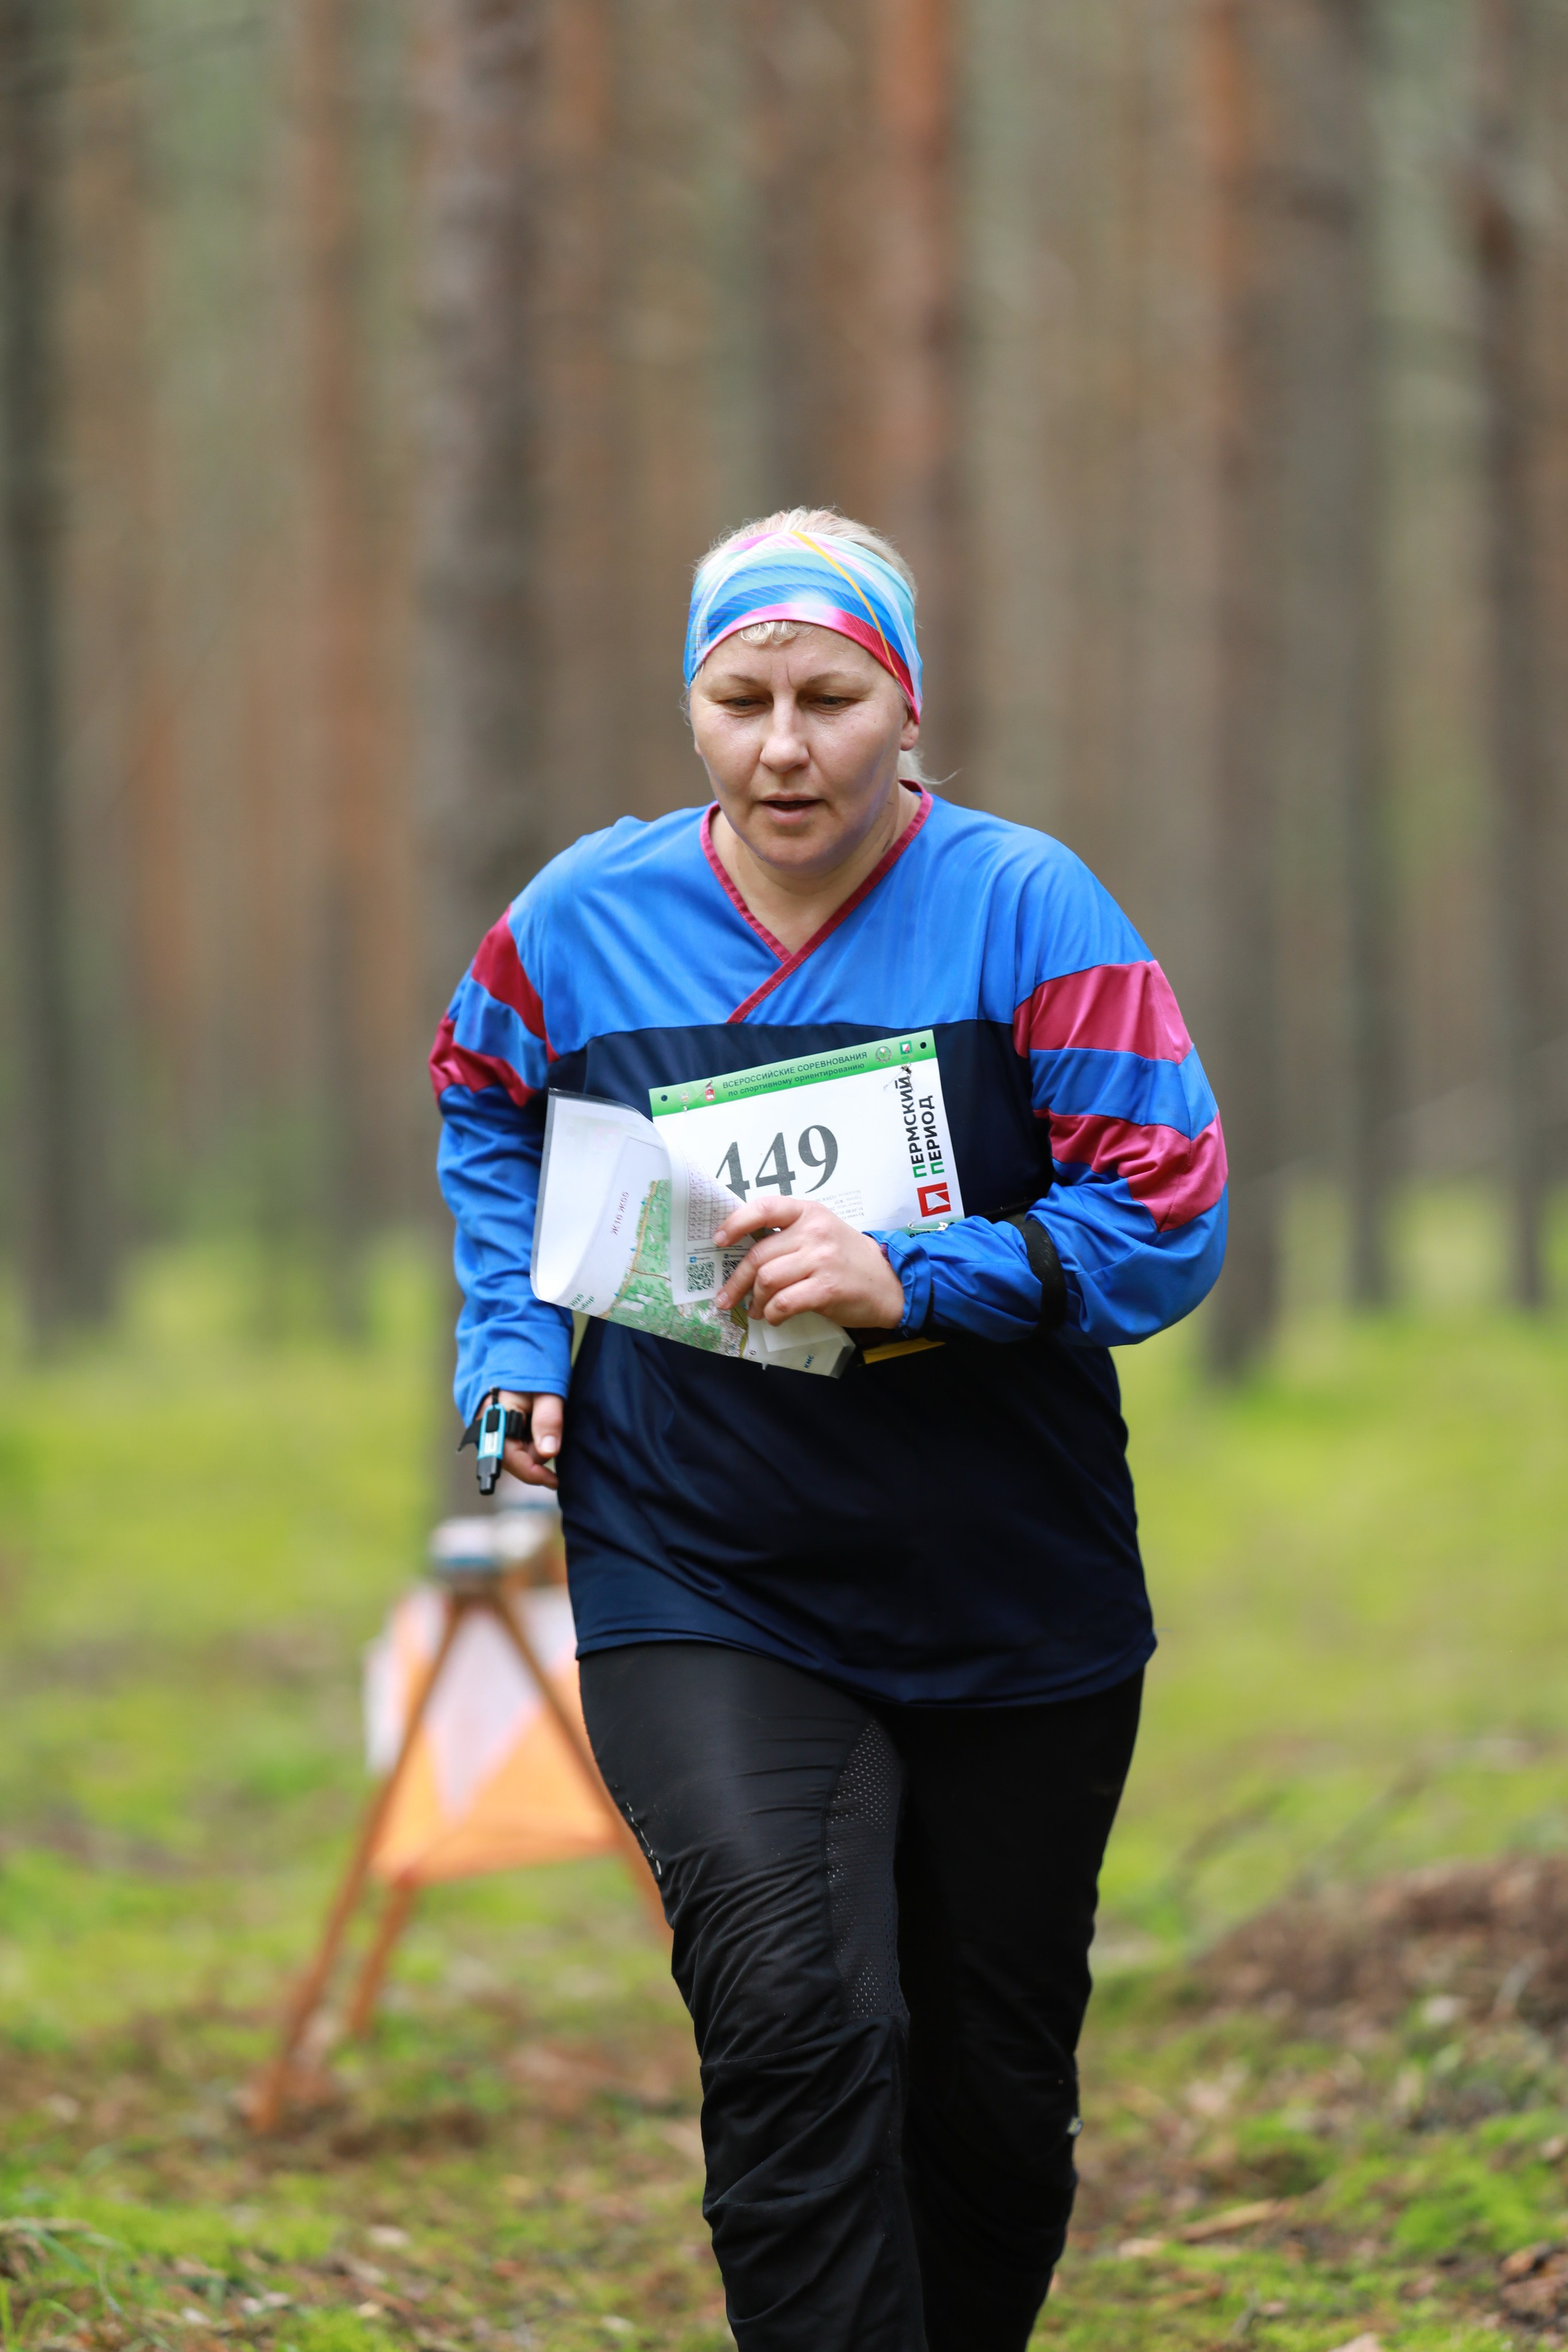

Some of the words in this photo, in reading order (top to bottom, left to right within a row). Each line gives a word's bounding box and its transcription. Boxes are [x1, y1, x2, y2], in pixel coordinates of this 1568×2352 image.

[723, 1066, 795, 1089] ВСЕРОССИЙСКИЕ
[797, 1052, 868, 1072] СОРЕВНОВАНИЯ
[740, 1077, 793, 1095] спортивному
[795, 1063, 864, 1082] ориентированию
[715, 1125, 838, 1204] 449
[894, 1076, 927, 1178] ПЕРМСКИЙ
[919, 1095, 945, 1175] ПЕРИОД
